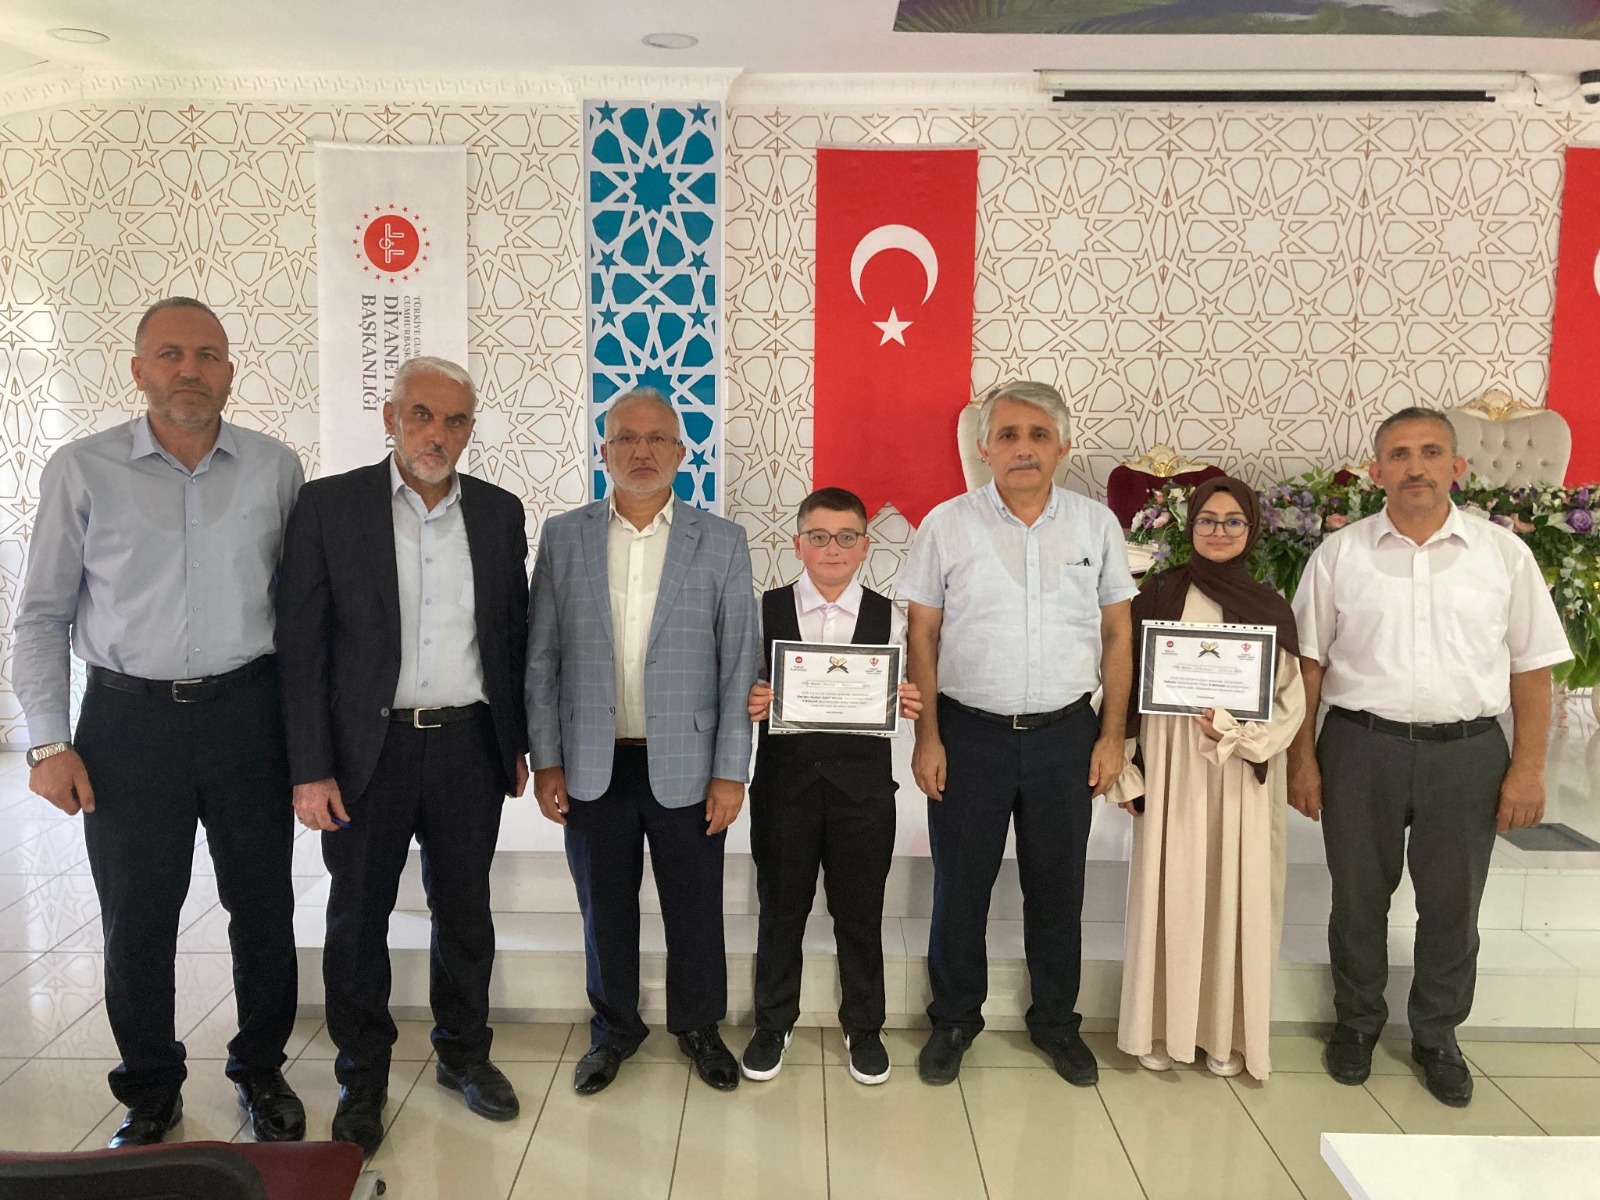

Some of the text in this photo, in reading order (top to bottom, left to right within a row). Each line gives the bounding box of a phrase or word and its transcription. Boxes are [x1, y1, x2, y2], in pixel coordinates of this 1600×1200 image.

[402, 295, 411, 359] CUMHURBAŞK
[413, 295, 422, 336] TÜRKİYE
[358, 294, 382, 413] BAŞKANLIĞI
